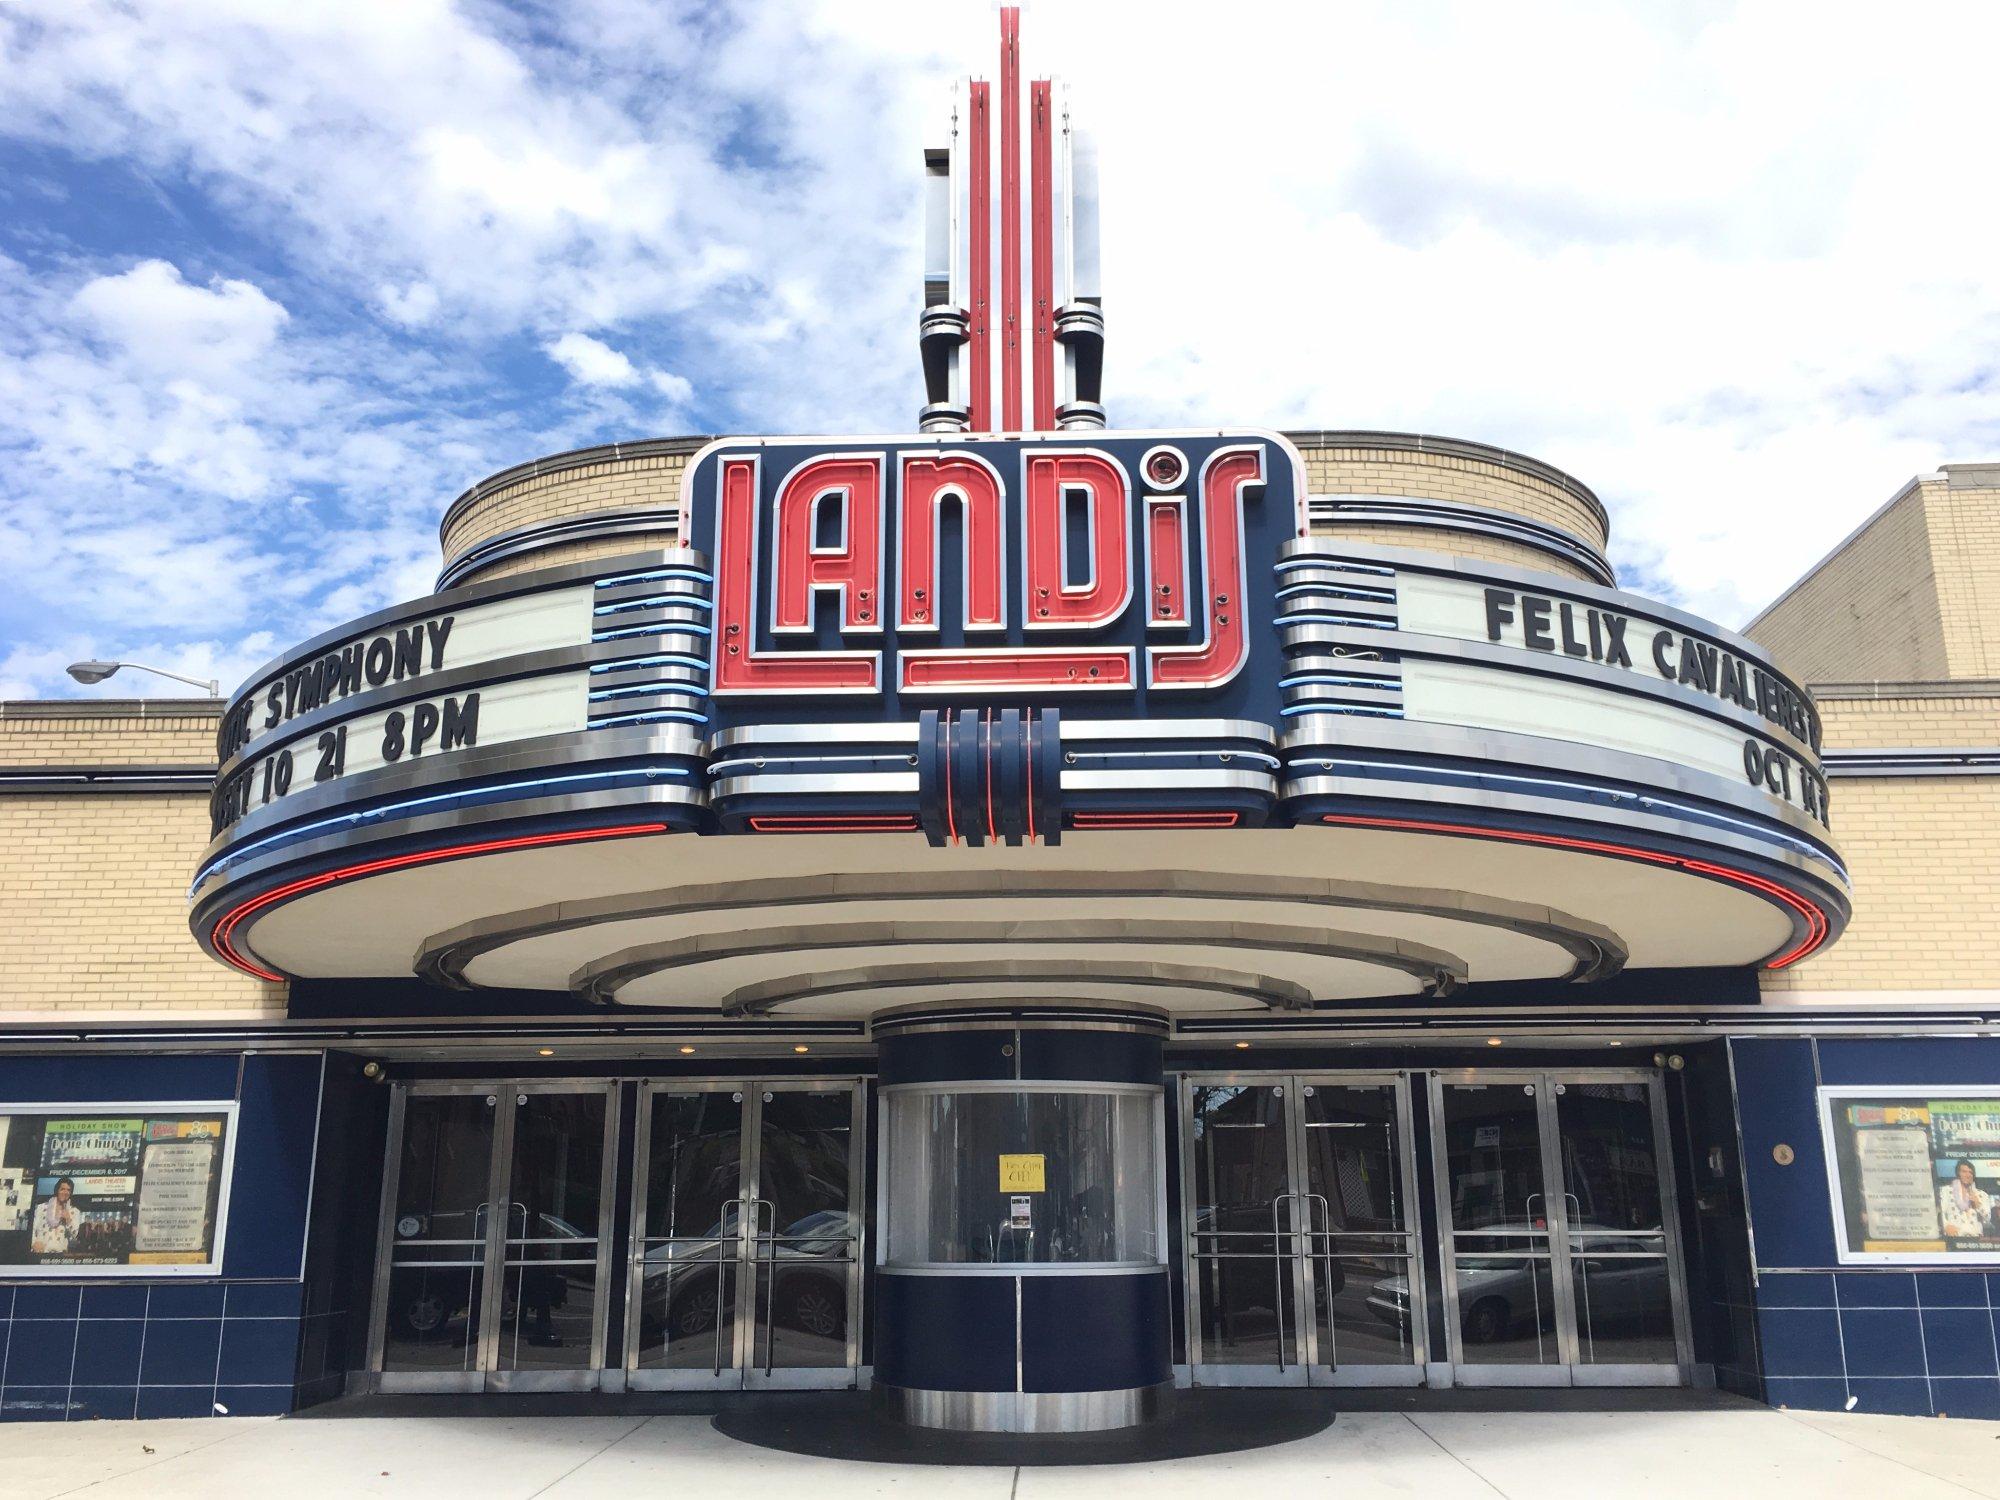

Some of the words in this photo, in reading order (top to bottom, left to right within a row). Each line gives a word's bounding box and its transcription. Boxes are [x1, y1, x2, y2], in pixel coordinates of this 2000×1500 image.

[1484, 588, 1632, 667] FELIX
[265, 616, 454, 730] SYMPHONY
[261, 750, 293, 804] 10
[314, 725, 347, 782] 21
[1743, 739, 1791, 800] OCT
[86, 1137, 133, 1150] Church
